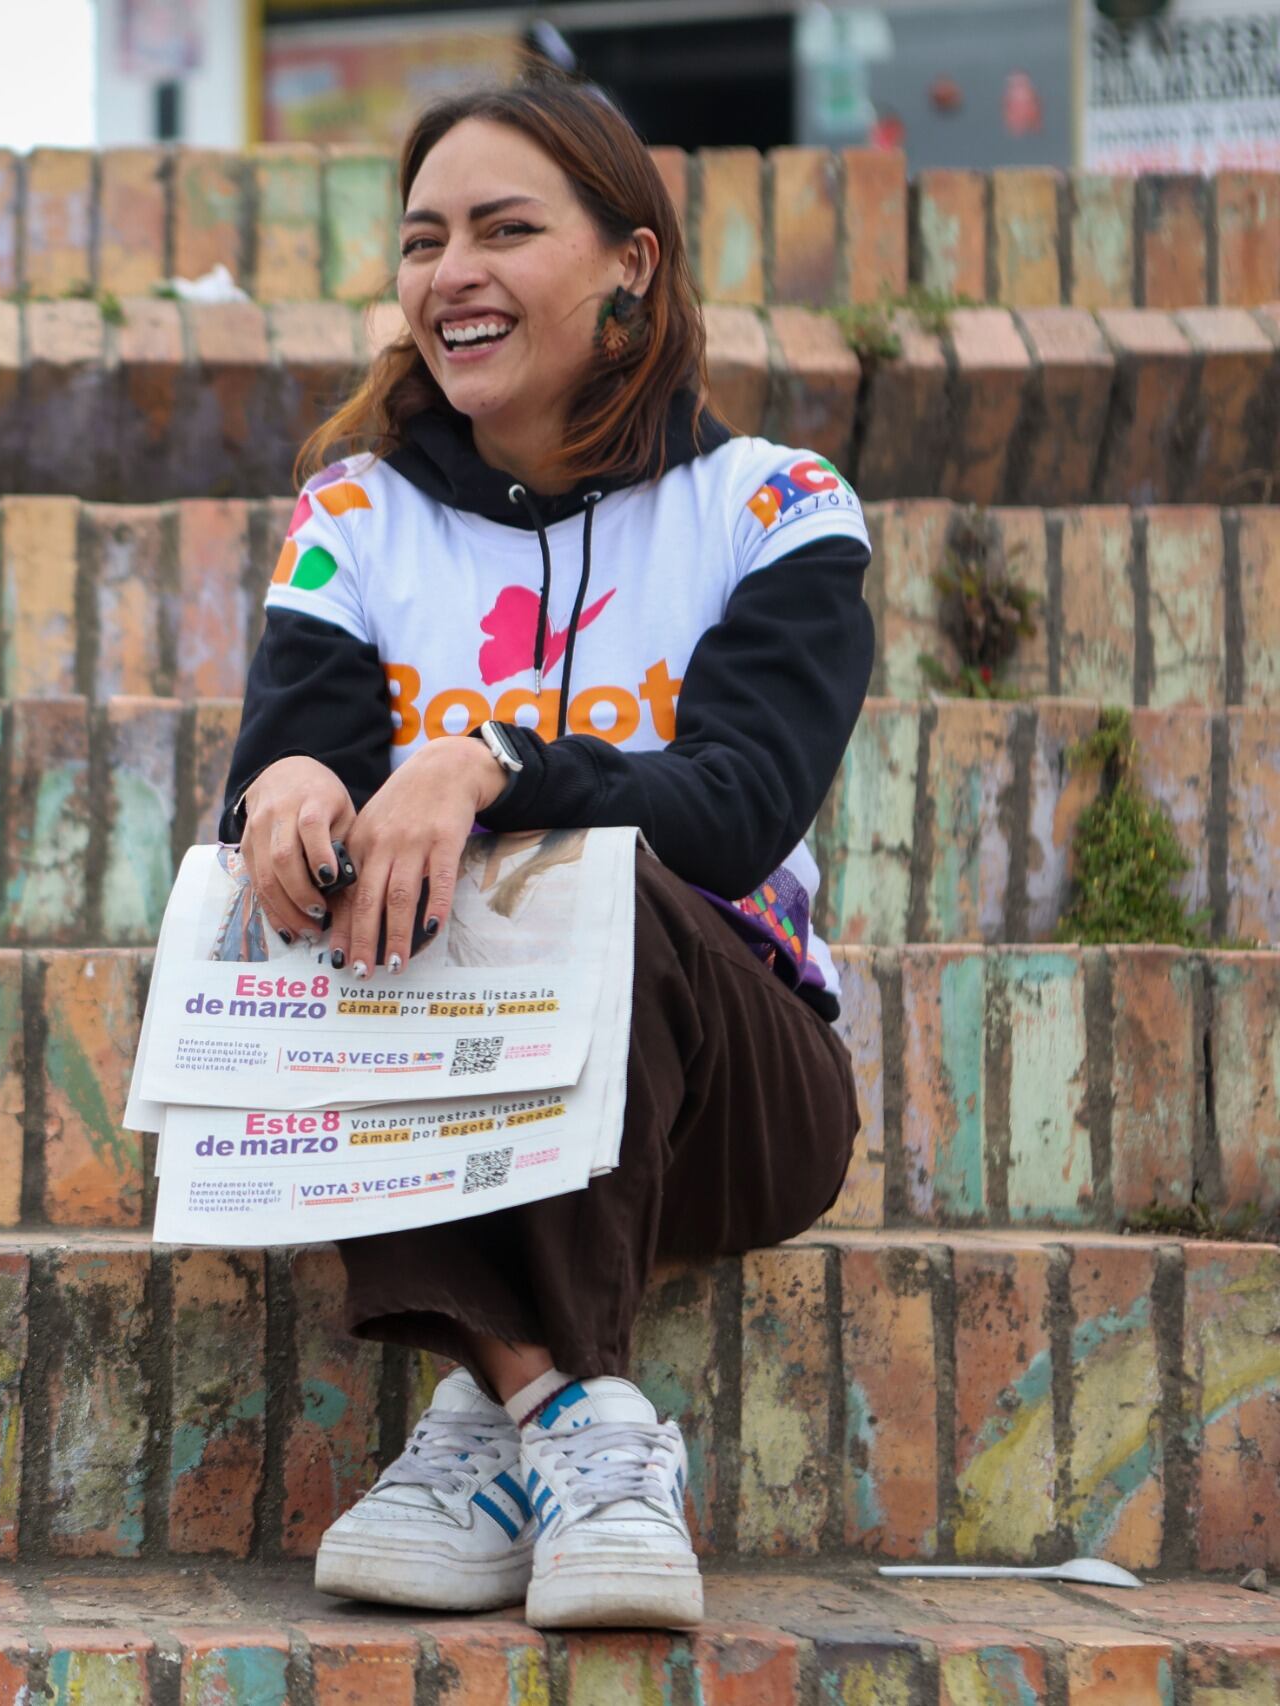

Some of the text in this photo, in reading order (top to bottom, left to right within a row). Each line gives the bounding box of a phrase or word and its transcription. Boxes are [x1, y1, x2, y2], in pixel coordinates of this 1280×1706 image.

[384, 658, 682, 746] Bogot
[236, 975, 330, 998] Este 8
[340, 987, 555, 1001] Vota por nuestras listas a la
[185, 993, 327, 1019] de marzo
[337, 1001, 560, 1017] Cámara por Bogotá y Senado.
[287, 1050, 335, 1064] VOTA
[336, 1052, 346, 1064] 3
[349, 1052, 409, 1064] VECES
[245, 1110, 340, 1135] Este 8
[351, 1095, 562, 1129] Vota por nuestras listas a la
[349, 1106, 567, 1145] Cámara por Bogotá y Senado.
[195, 1135, 338, 1157] de marzo
[300, 1183, 348, 1197] VOTA
[351, 1182, 360, 1194] 3
[362, 1175, 421, 1193] VECES
